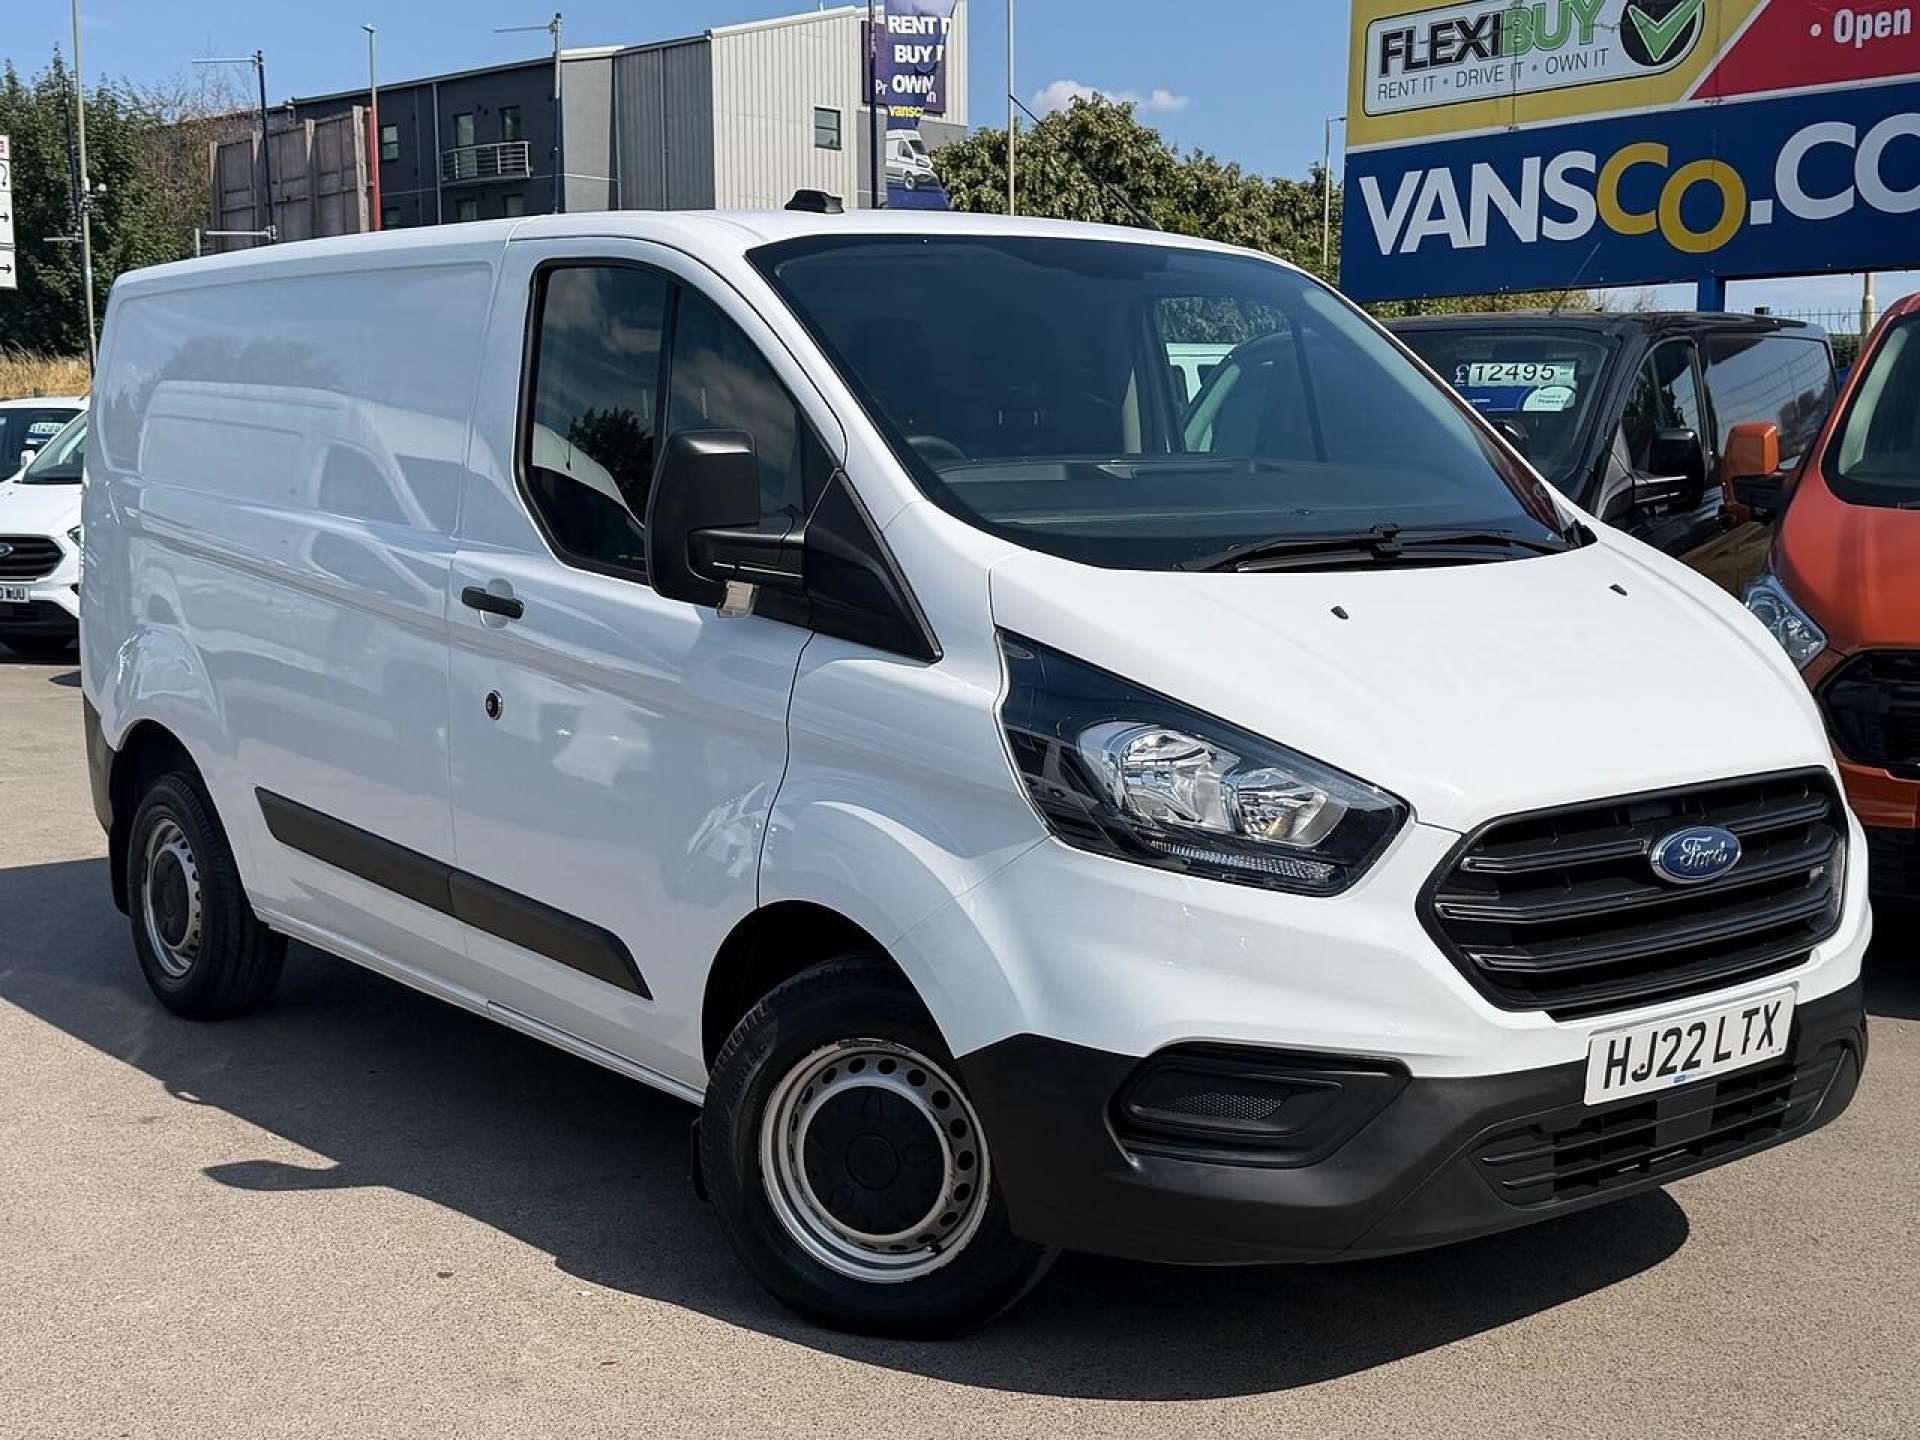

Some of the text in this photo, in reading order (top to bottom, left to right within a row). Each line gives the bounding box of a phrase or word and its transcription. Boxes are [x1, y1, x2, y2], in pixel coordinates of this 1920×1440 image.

[887, 15, 937, 34] RENT
[1379, 0, 1602, 78] FLEXIBUY
[1834, 8, 1912, 49] Open
[894, 45, 945, 63] BUY I
[891, 75, 935, 93] OWN
[1377, 48, 1609, 101] RENT IT DRIVE IT OWN IT
[1679, 836, 1728, 868] Ford
[1603, 1001, 1782, 1090] HJ22 LTX
